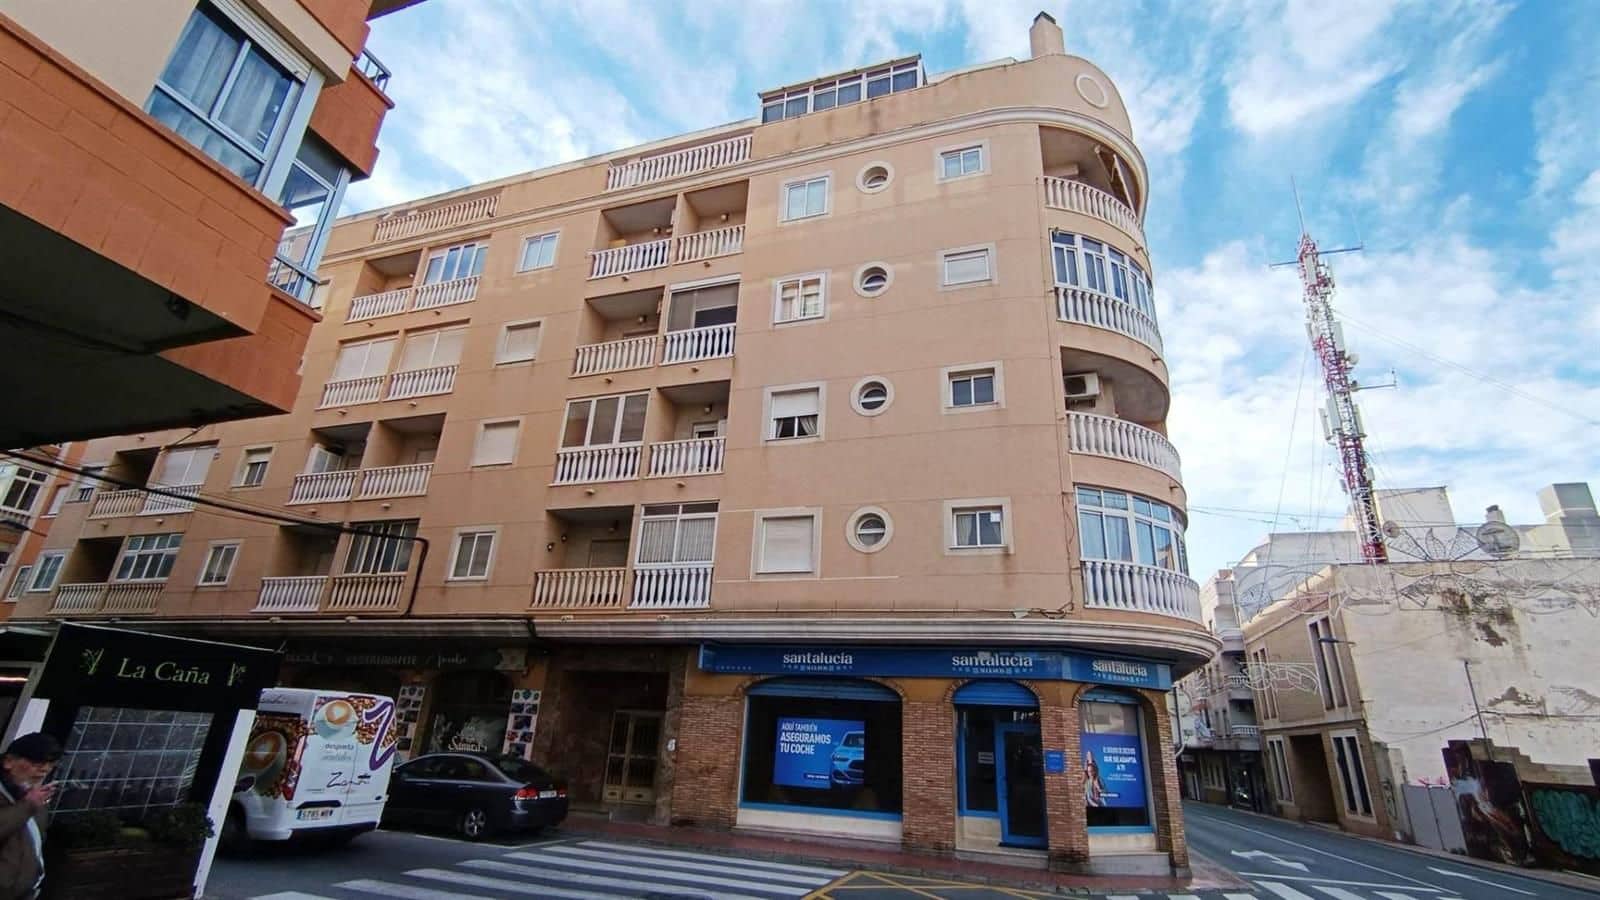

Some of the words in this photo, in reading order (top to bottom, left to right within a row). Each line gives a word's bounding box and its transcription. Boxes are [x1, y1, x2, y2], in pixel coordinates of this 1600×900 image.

[117, 657, 147, 679] La
[154, 661, 211, 685] Caña
[780, 732, 832, 744] ASEGURAMOS
[780, 742, 790, 753] TU
[790, 743, 815, 755] COCHE
